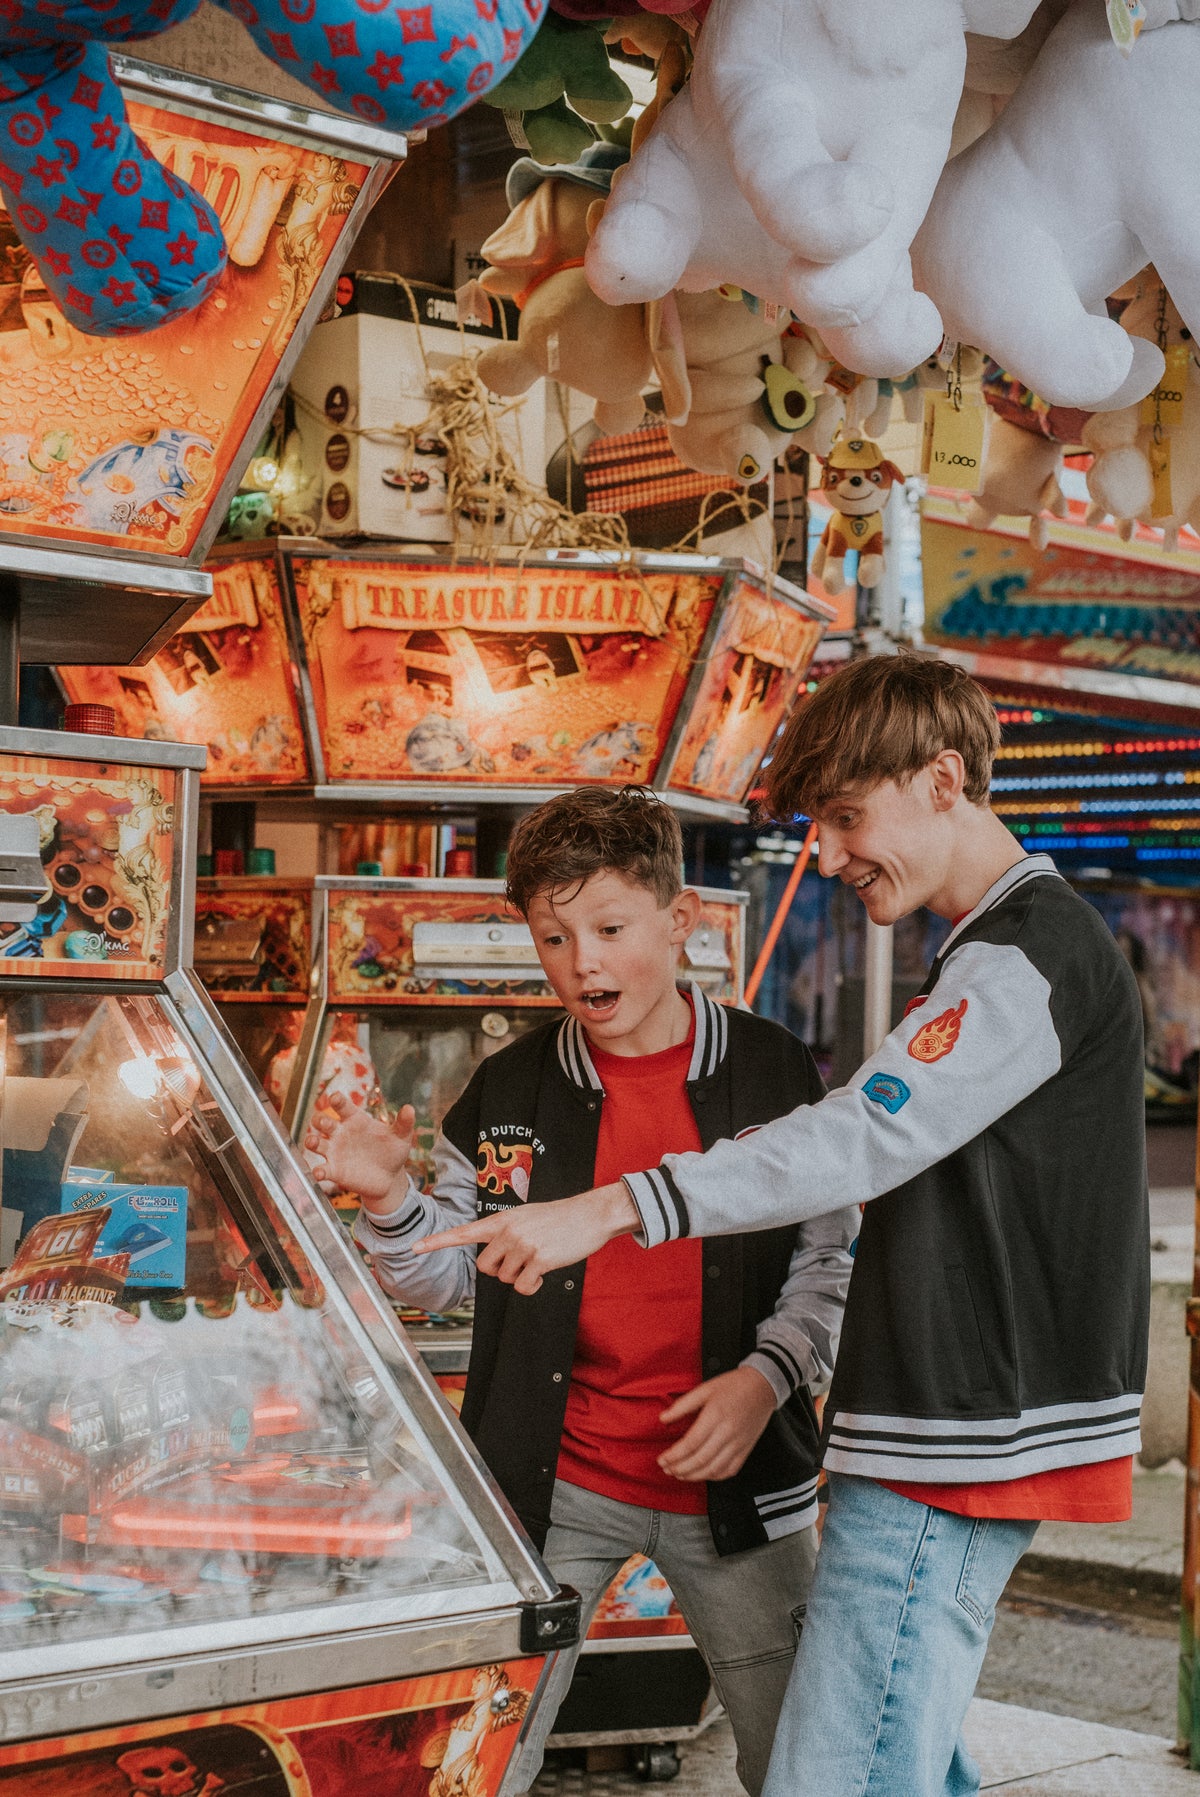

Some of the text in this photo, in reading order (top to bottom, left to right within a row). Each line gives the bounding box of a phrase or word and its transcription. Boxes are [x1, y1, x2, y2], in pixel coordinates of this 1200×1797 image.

[366, 584, 530, 621] TREASURE
[104, 940, 130, 951] KMG
[71, 1191, 93, 1209] EXTRA
[59, 1285, 117, 1305] MACHINE
